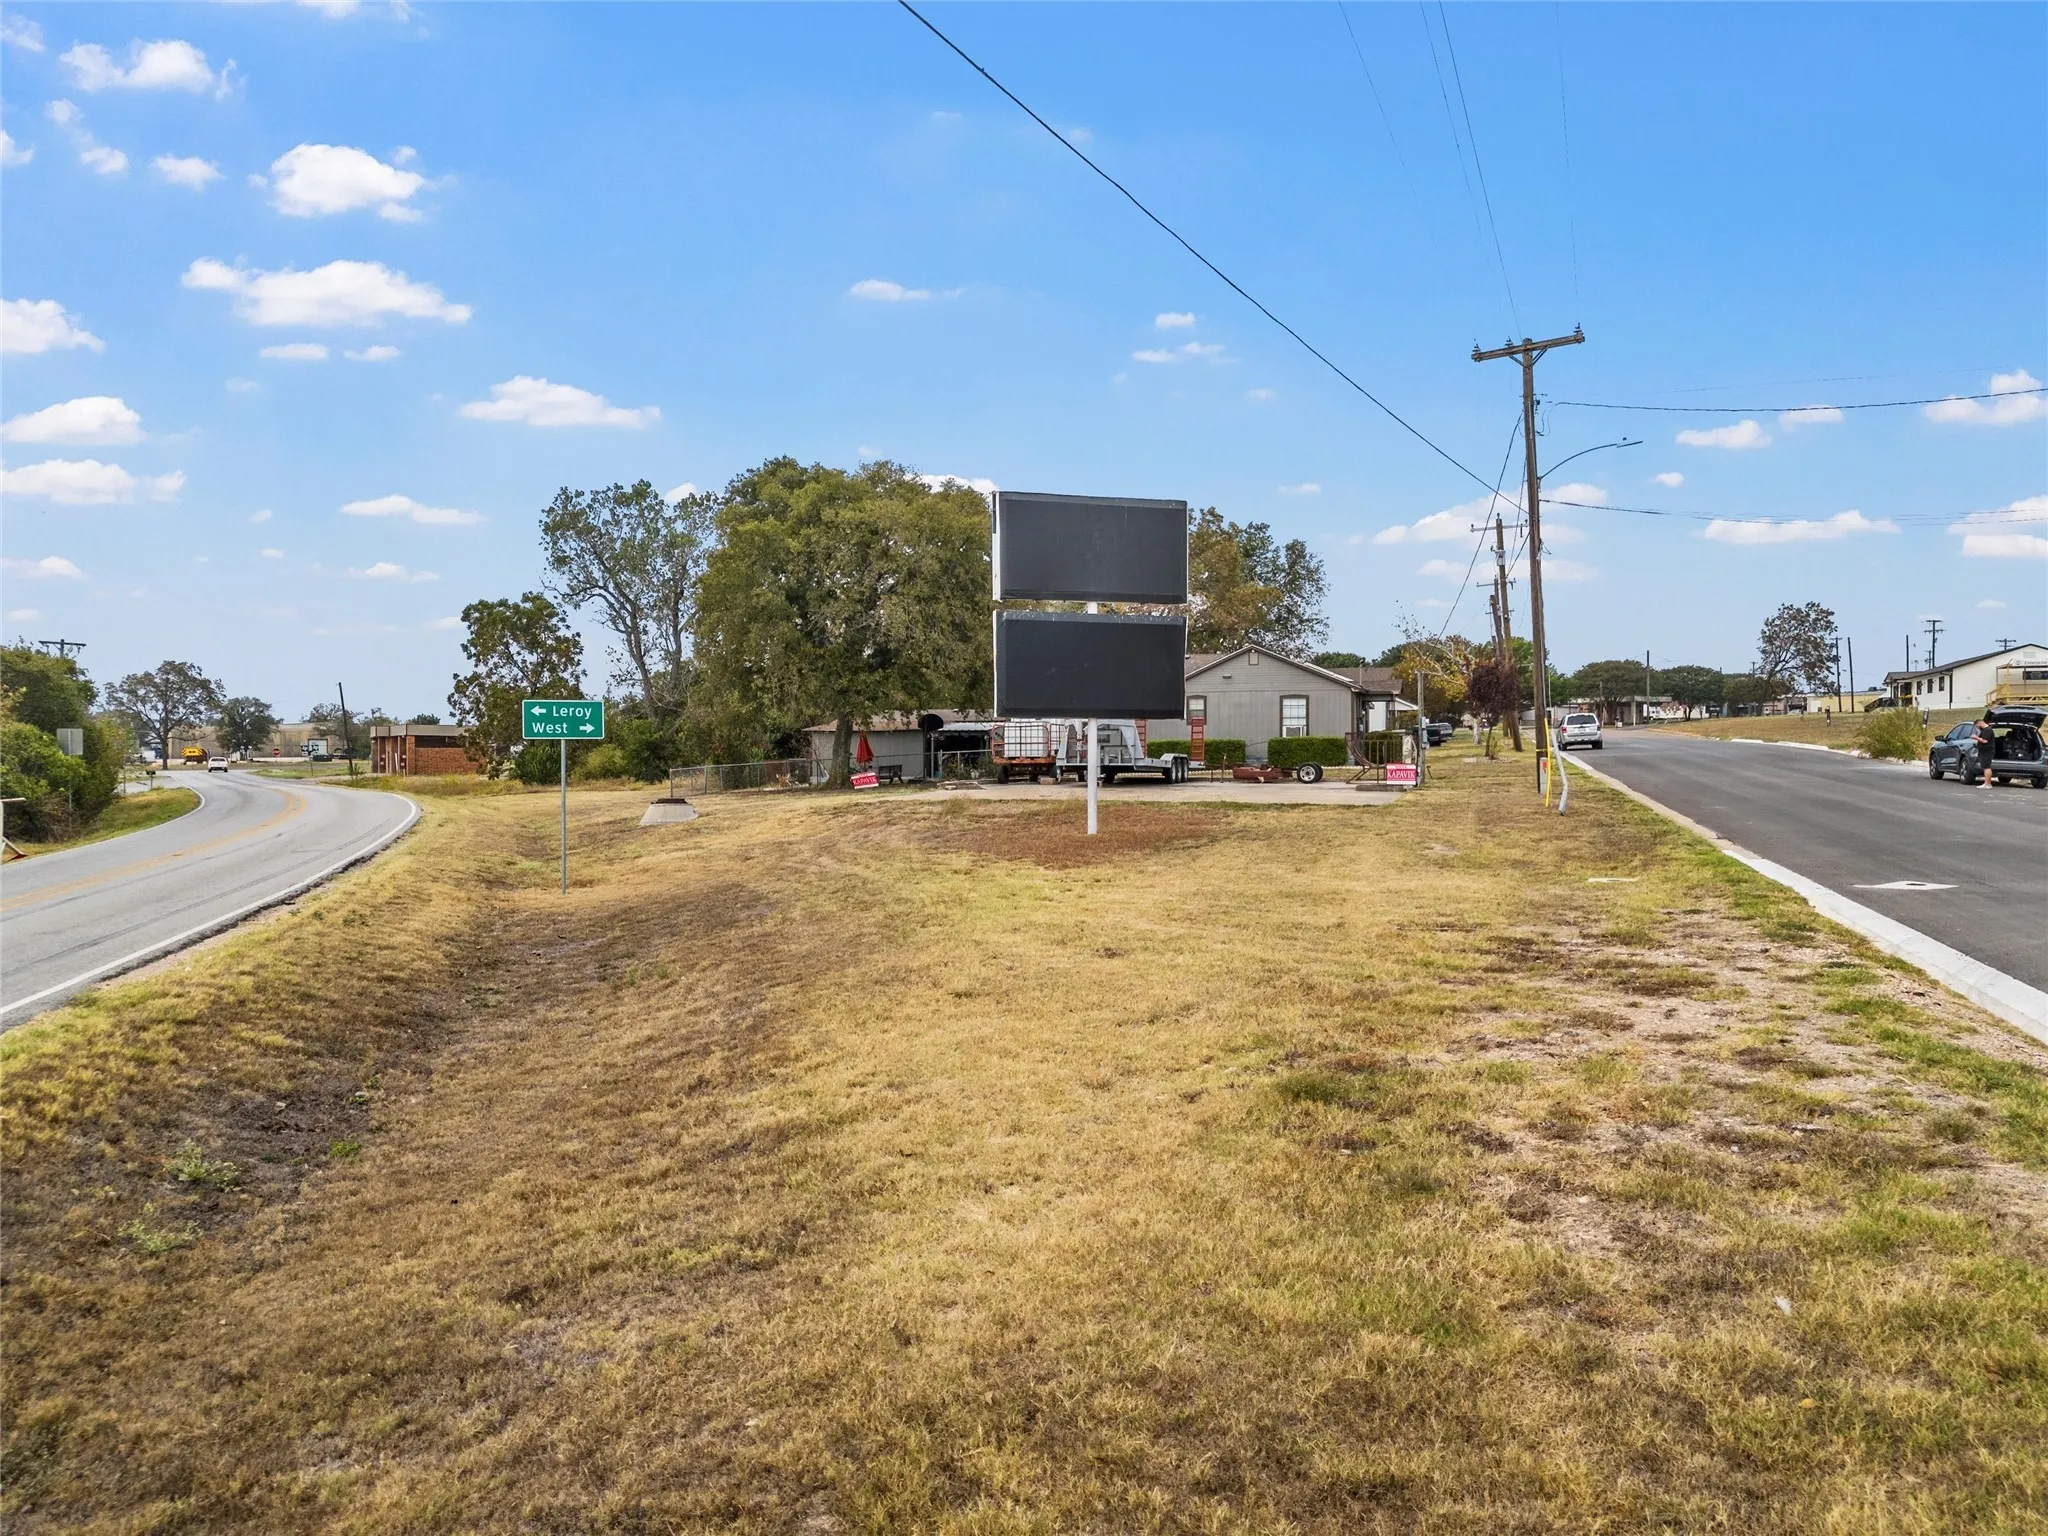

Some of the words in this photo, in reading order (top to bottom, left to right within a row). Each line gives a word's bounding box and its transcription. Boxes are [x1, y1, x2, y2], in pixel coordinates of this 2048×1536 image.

[553, 706, 592, 720] Leroy
[532, 722, 568, 734] West
[1387, 771, 1416, 779] KAPAVIK
